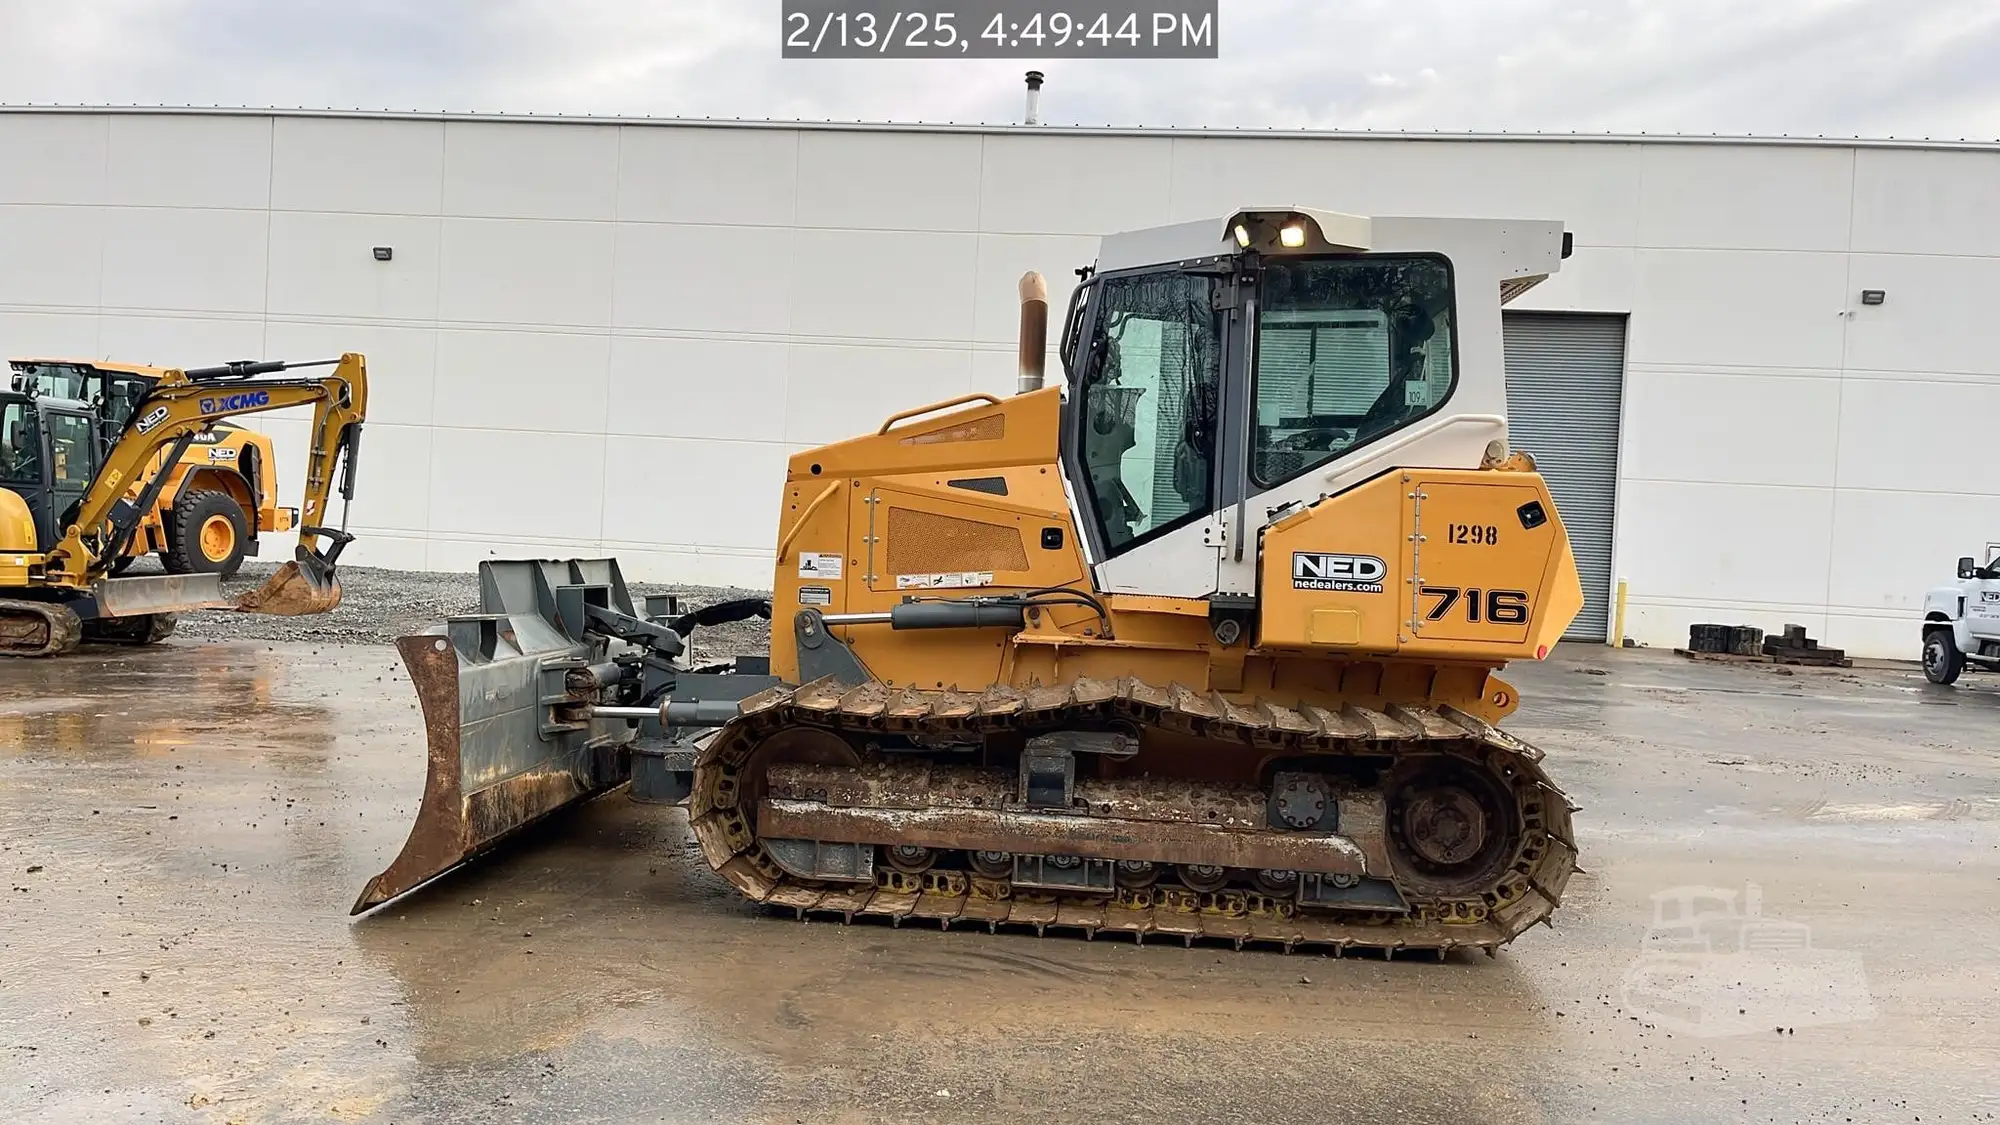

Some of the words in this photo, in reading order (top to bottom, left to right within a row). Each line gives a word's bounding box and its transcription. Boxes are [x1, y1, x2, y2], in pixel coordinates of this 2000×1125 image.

[218, 391, 269, 411] XCMG
[136, 406, 168, 432] NED
[208, 448, 237, 458] NED
[1448, 523, 1498, 546] 1298
[1295, 555, 1384, 580] NED
[1294, 579, 1382, 592] nedealers.com
[1419, 586, 1530, 625] 716
[1981, 592, 2000, 602] NED
